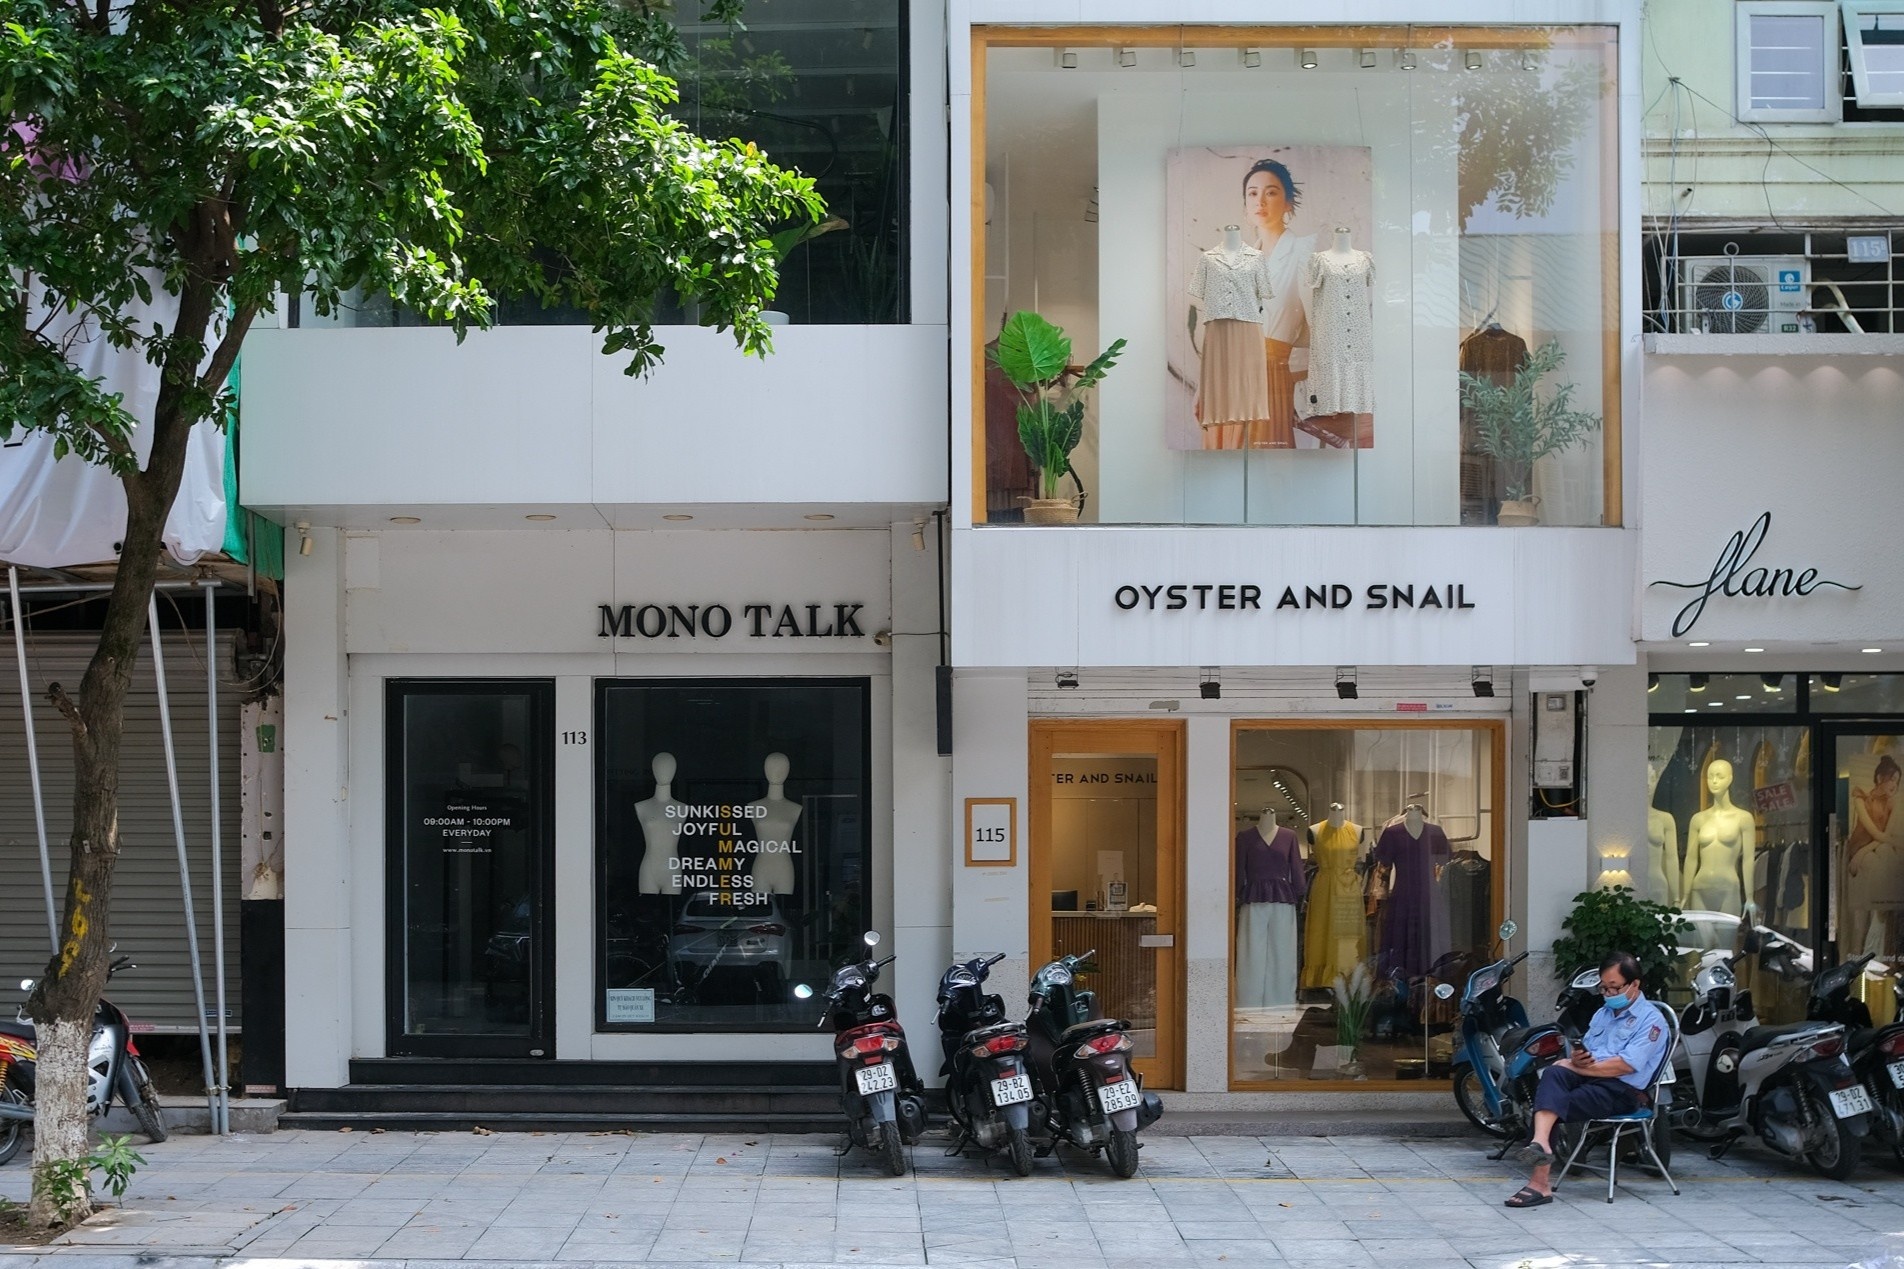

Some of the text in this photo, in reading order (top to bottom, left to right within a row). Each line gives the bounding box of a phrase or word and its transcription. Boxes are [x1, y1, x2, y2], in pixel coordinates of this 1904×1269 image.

[1115, 584, 1475, 610] OYSTER AND SNAIL
[598, 604, 865, 638] MONO TALK
[561, 731, 587, 745] 113
[1079, 773, 1109, 784] AND
[1114, 773, 1157, 784] SNAIL
[446, 804, 470, 812] Opening
[665, 805, 768, 818] SUNKISSED
[423, 818, 465, 826] 09:00AM
[472, 818, 511, 826] 10:00PM
[672, 822, 742, 836] JOYFUL
[442, 829, 492, 837] EVERYDAY
[975, 827, 1006, 842] 115
[718, 840, 802, 853] MAGICAL
[668, 857, 746, 871] DREAMY
[672, 874, 754, 888] ENDLESS
[709, 892, 768, 905] FRESH
[997, 1077, 1024, 1091] 29-B2
[1104, 1083, 1131, 1099] 29-E2
[997, 1087, 1030, 1103] 134.05
[1104, 1094, 1138, 1111] 285.99
